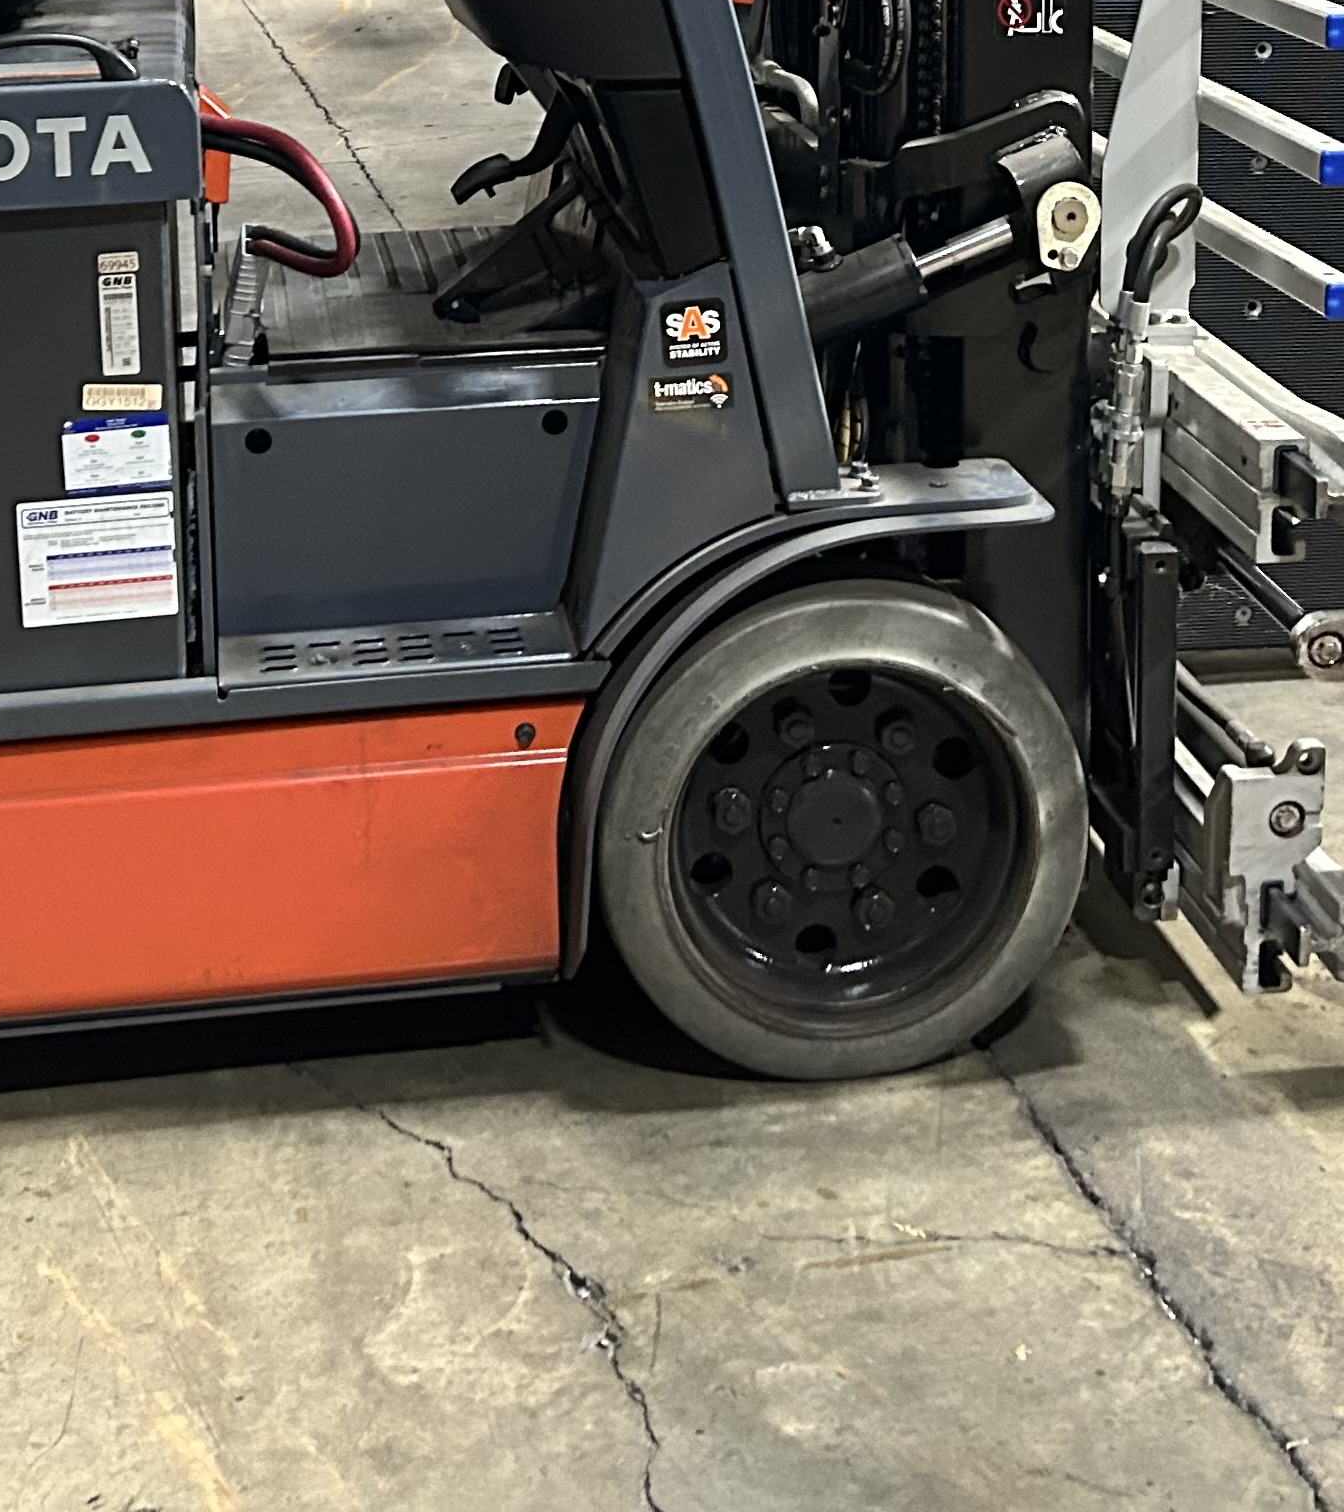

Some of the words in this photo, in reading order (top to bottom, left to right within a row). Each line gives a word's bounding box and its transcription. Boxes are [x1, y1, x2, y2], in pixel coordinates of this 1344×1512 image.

[102, 276, 132, 286] GNB
[665, 306, 721, 341] SAS
[669, 347, 721, 359] STABILITY
[654, 378, 713, 397] t-matics
[26, 510, 59, 521] GNB
